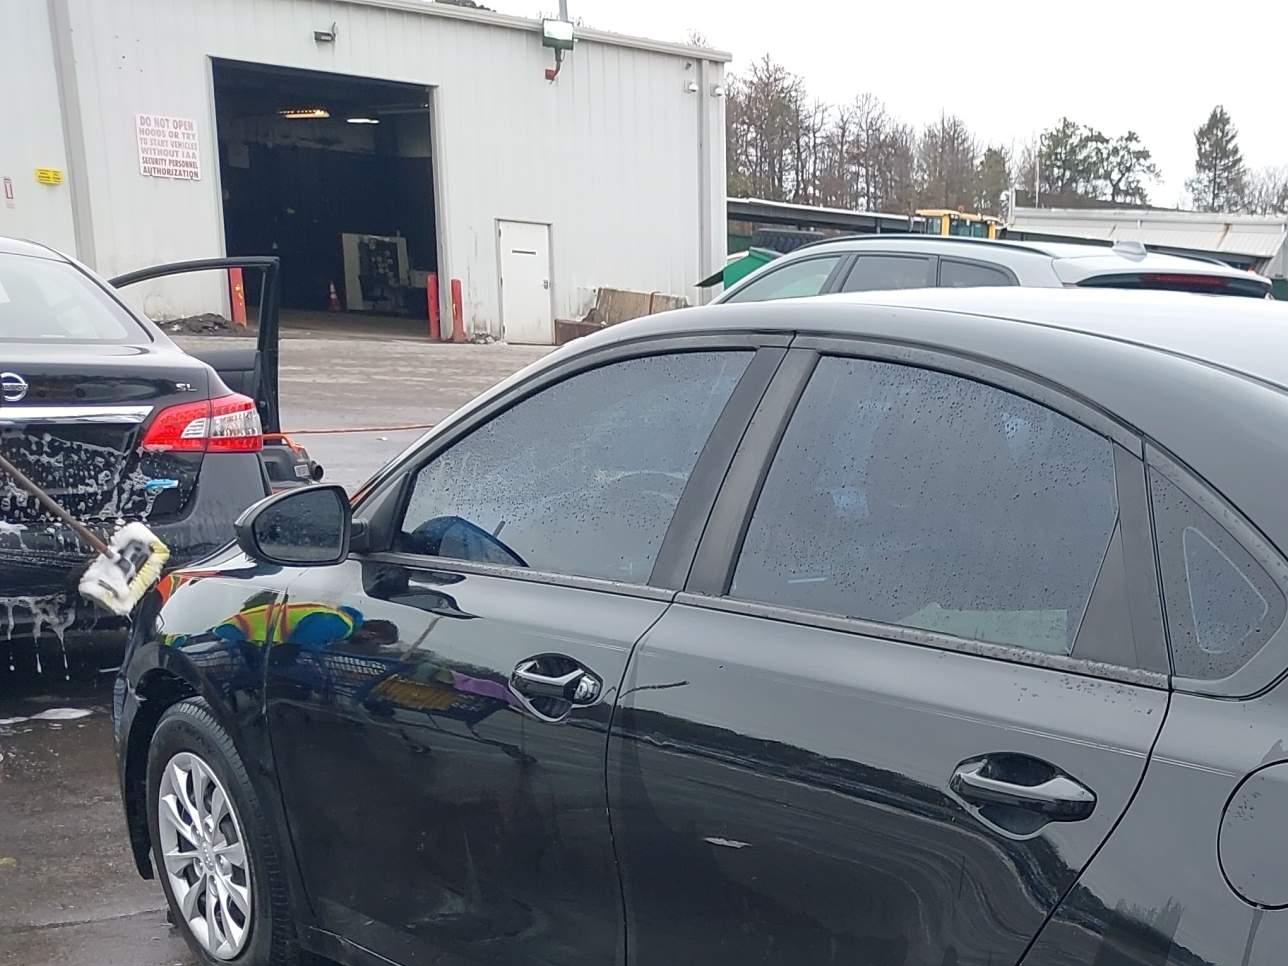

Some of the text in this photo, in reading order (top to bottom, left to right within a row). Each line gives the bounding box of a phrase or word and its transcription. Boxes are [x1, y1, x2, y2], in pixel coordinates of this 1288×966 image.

[140, 116, 194, 131] DO NOT OPEN
[139, 128, 196, 140] HOODS OR TRY
[140, 137, 198, 151] TO START VEHICLES
[141, 147, 197, 160] WITHOUT IAA
[142, 156, 198, 169] SECURITY PERSONNEL
[143, 166, 199, 179] AUTHORIZATION
[175, 383, 199, 392] SL
